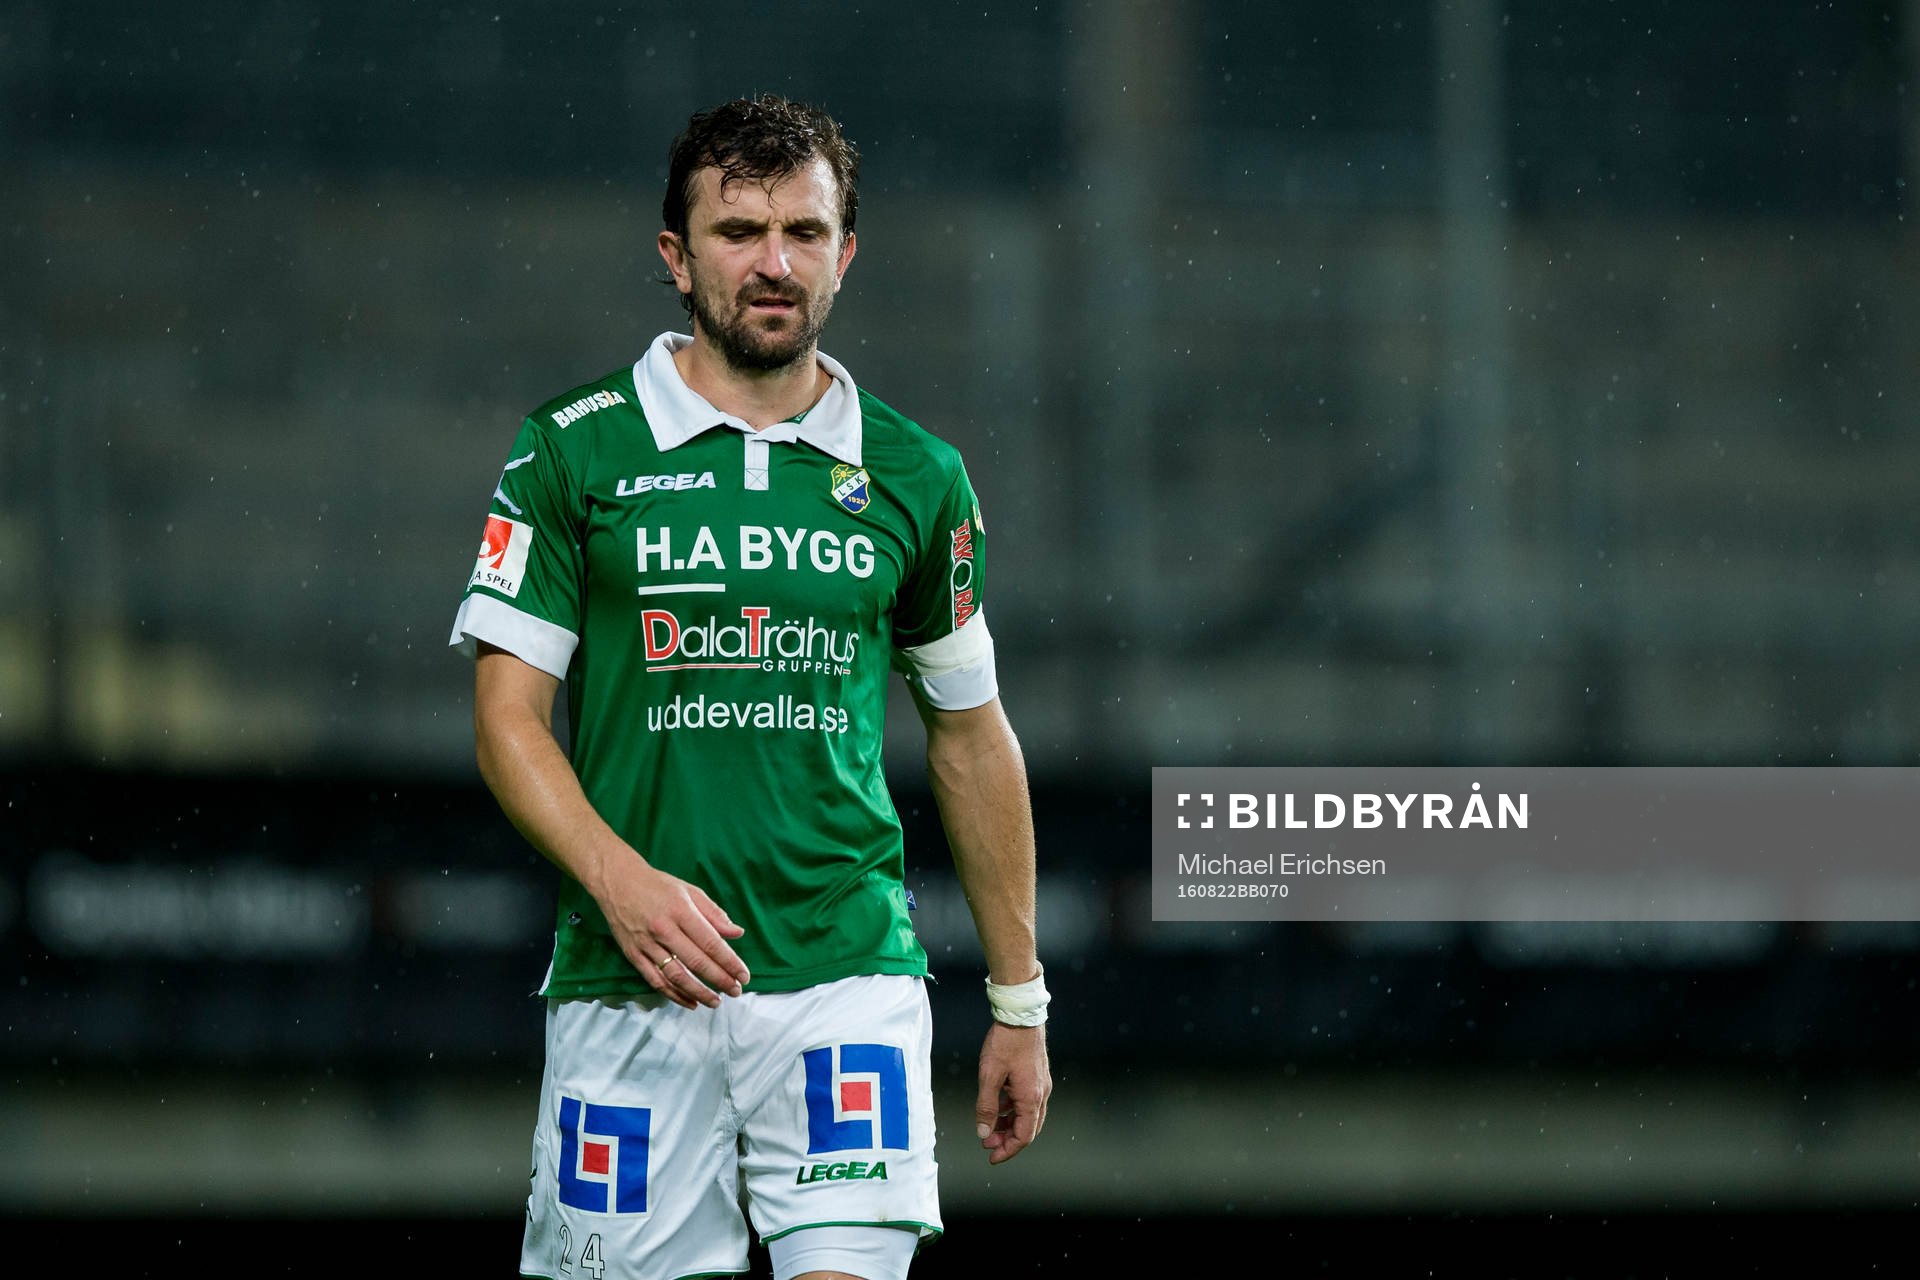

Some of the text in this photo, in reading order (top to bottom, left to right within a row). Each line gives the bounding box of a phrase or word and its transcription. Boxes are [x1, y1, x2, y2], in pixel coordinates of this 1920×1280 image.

[615, 471, 716, 497] LEGEA
[636, 525, 875, 578] H.A BYGG
[485, 572, 513, 592] SPEL
[641, 606, 859, 664] DalaTrähus
[762, 660, 843, 676] GRUPPEN
[648, 694, 848, 734] uddevalla.se
[796, 1161, 888, 1186] LEGEA
[559, 1224, 605, 1280] 24
